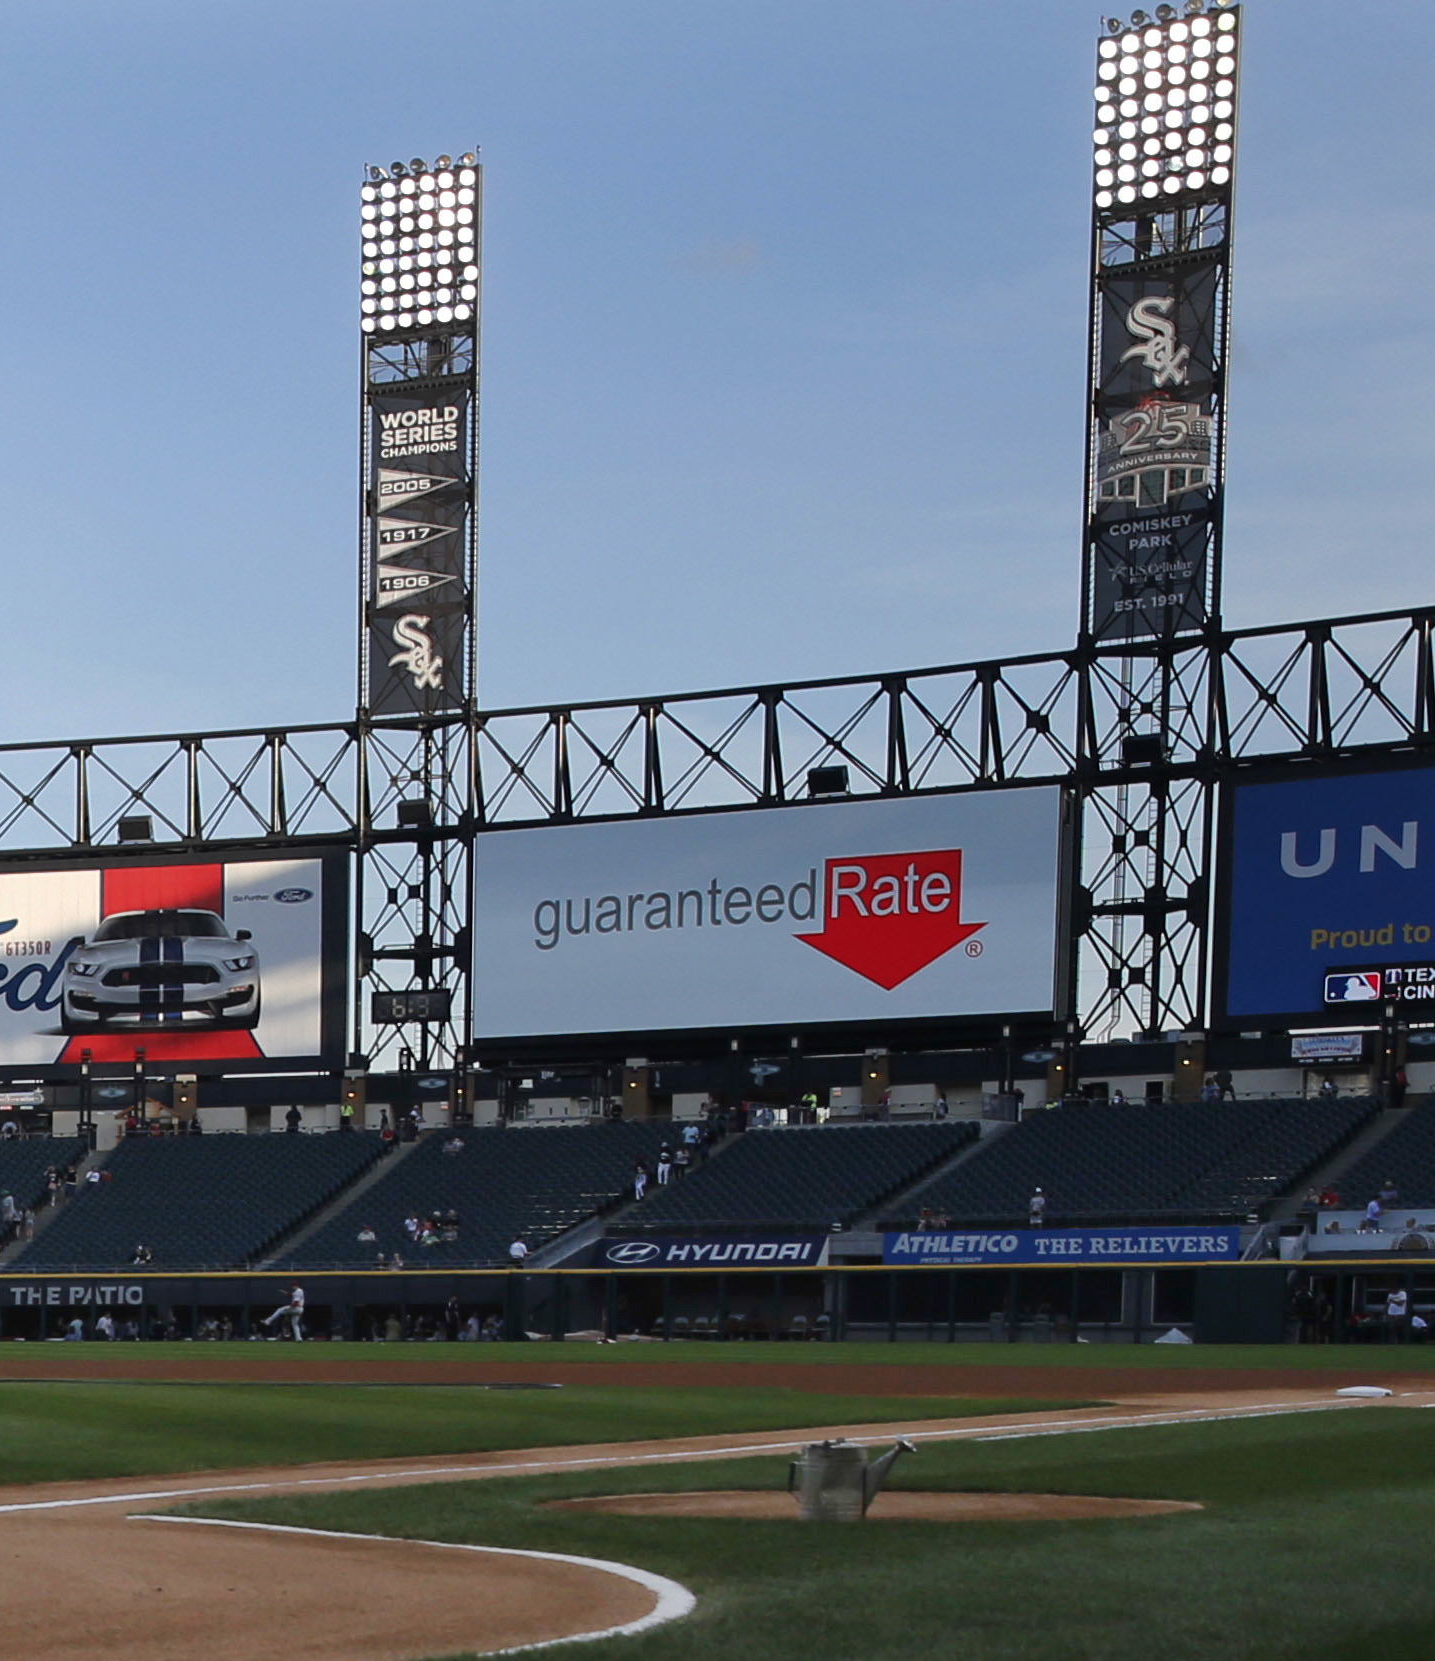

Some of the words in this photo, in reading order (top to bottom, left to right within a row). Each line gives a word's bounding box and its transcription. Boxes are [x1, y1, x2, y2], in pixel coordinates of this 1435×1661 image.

[380, 406, 459, 429] WORLD
[380, 423, 458, 447] SERIES
[1119, 404, 1188, 457] 25
[380, 441, 458, 459] CHAMPIONS
[1107, 451, 1198, 473] ANNIVERSARY
[380, 477, 432, 496] 2005
[381, 525, 431, 544] 1917
[1108, 514, 1193, 537] COMISKEY
[1128, 533, 1173, 551] PARK
[381, 575, 431, 592] 1906
[1113, 598, 1147, 613] EST.
[1150, 592, 1186, 608] 1991
[533, 867, 818, 951] guaranteed
[830, 864, 953, 918] Rate
[1310, 923, 1394, 950] Proud
[1402, 923, 1431, 944] to
[6, 941, 51, 956] GT350R
[666, 1243, 812, 1261] HYUNDAI
[892, 1233, 1018, 1253] ATHLETICO
[1035, 1238, 1083, 1255] THE
[1089, 1236, 1230, 1254] RELIEVERS
[10, 1286, 62, 1305] THE
[69, 1285, 143, 1305] PATIO
